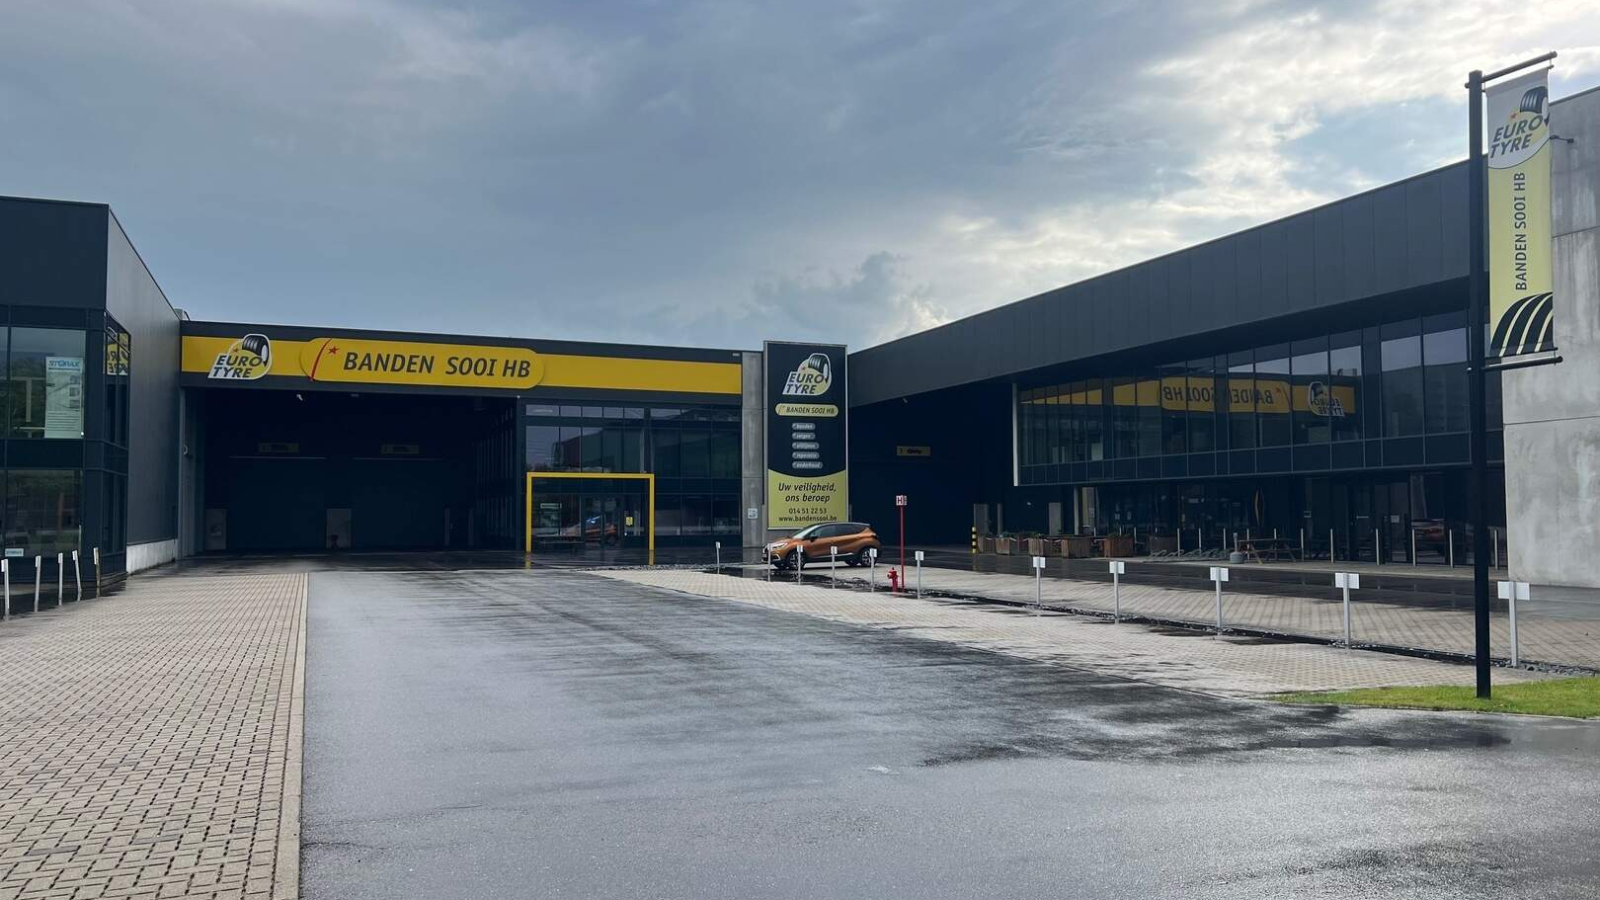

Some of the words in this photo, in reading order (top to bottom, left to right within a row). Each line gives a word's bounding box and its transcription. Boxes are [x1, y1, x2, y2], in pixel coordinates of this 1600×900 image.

[1493, 115, 1543, 142] EURO
[1490, 133, 1532, 158] TYRE
[1513, 172, 1525, 191] HB
[1514, 196, 1526, 229] SOOI
[1515, 234, 1527, 290] BANDEN
[216, 355, 262, 367] EURO
[343, 352, 434, 373] BANDEN
[445, 356, 497, 376] SOOI
[502, 359, 531, 378] HB
[213, 367, 252, 378] TYRE
[789, 373, 824, 384] EURO
[786, 384, 817, 394] TYRE
[786, 406, 810, 414] BANDEN
[778, 482, 791, 491] Uw
[794, 482, 836, 493] veiligheid,
[802, 494, 830, 504] beroep
